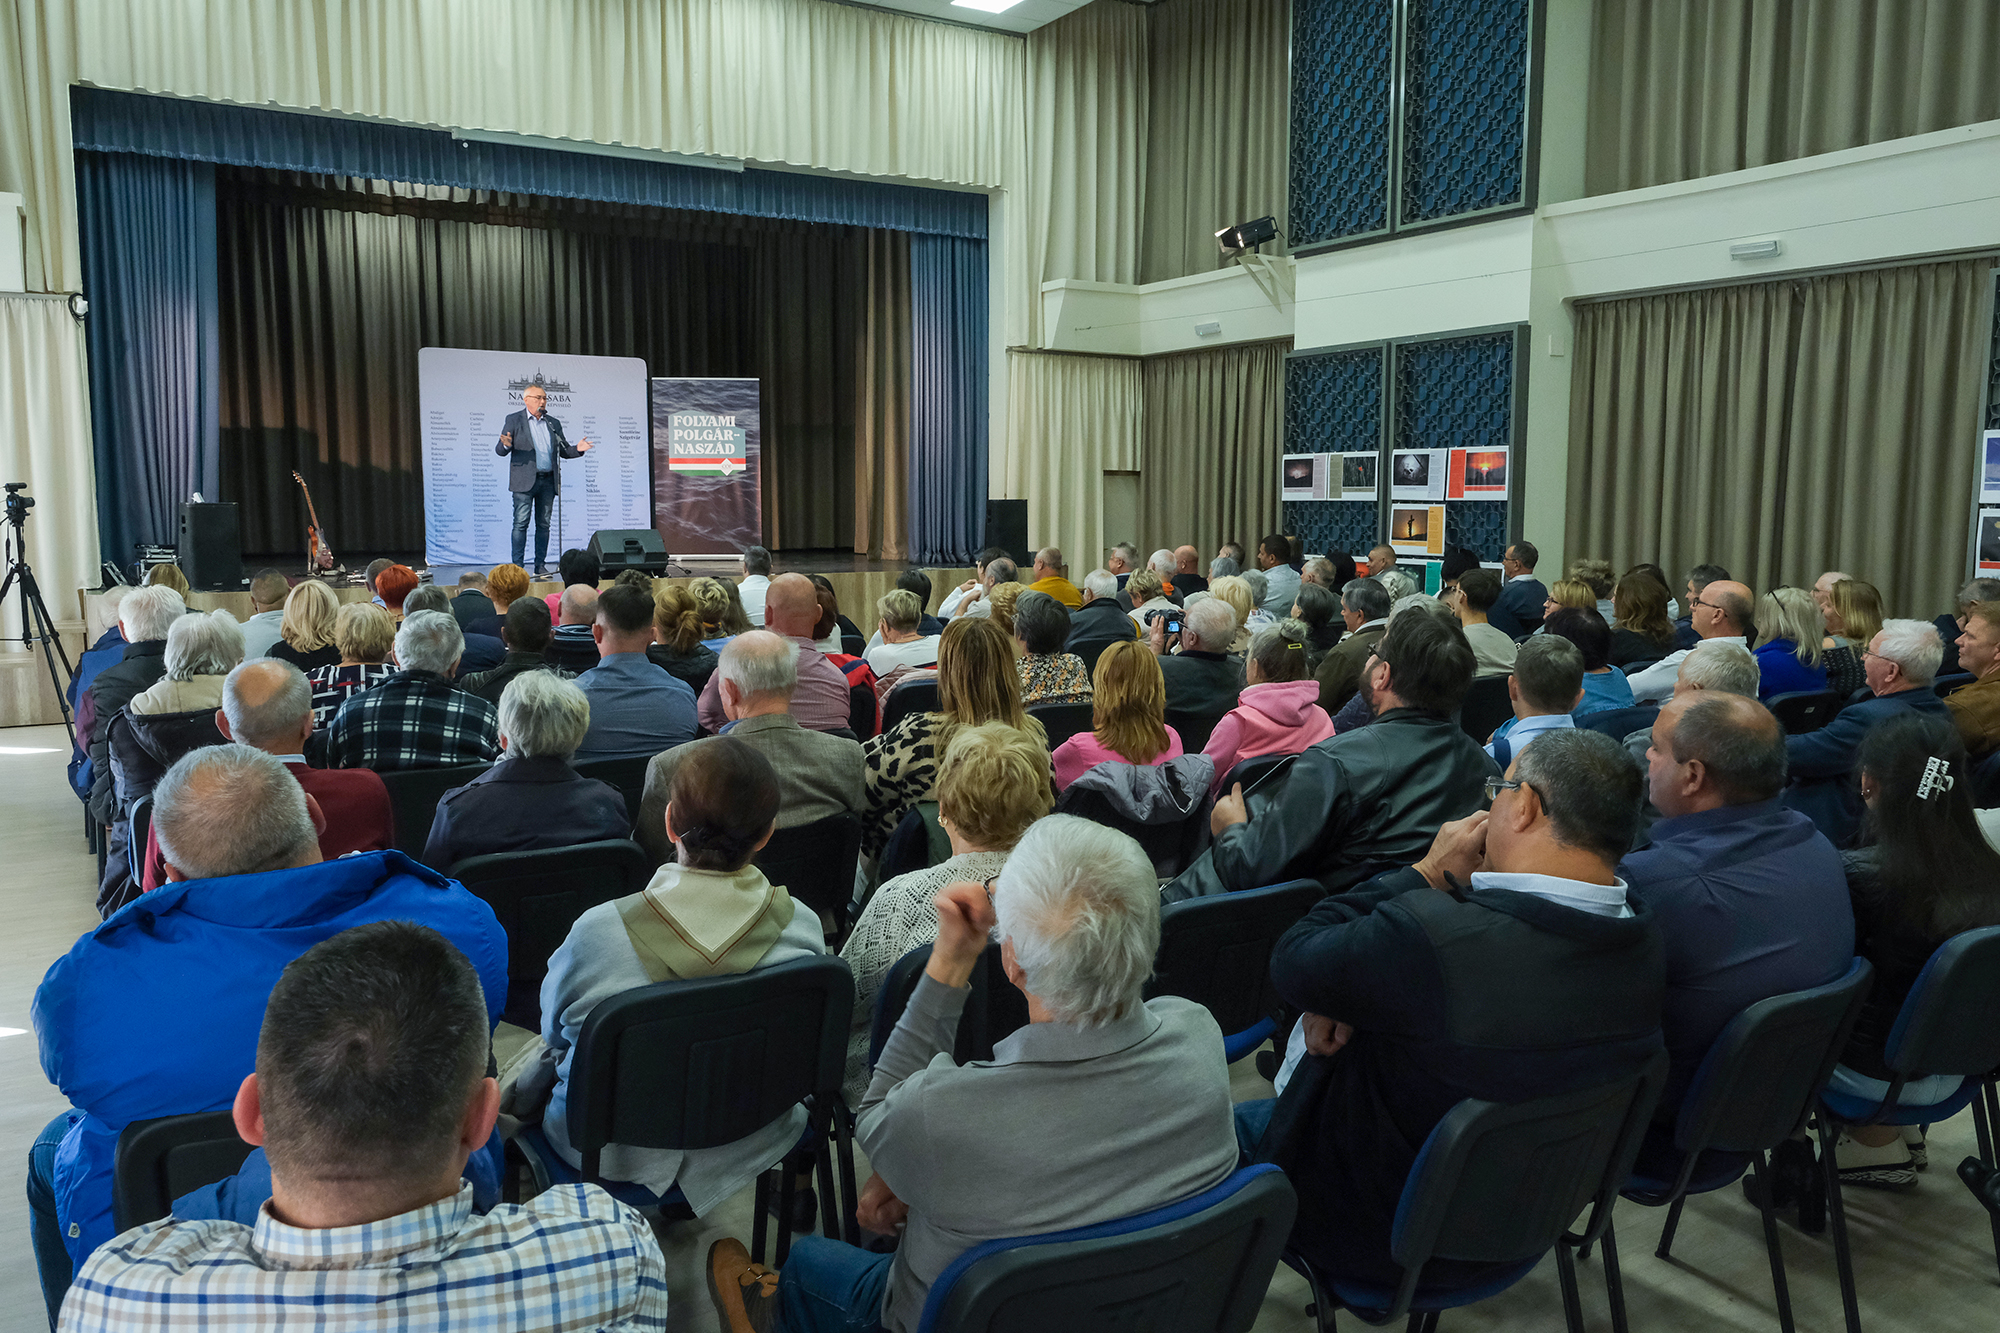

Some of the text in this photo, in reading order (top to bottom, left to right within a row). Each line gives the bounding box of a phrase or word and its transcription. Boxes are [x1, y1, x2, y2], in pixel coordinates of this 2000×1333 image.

[673, 416, 735, 427] FOLYAMI
[674, 427, 740, 440] POLGÁR-
[674, 442, 735, 454] NASZÁD
